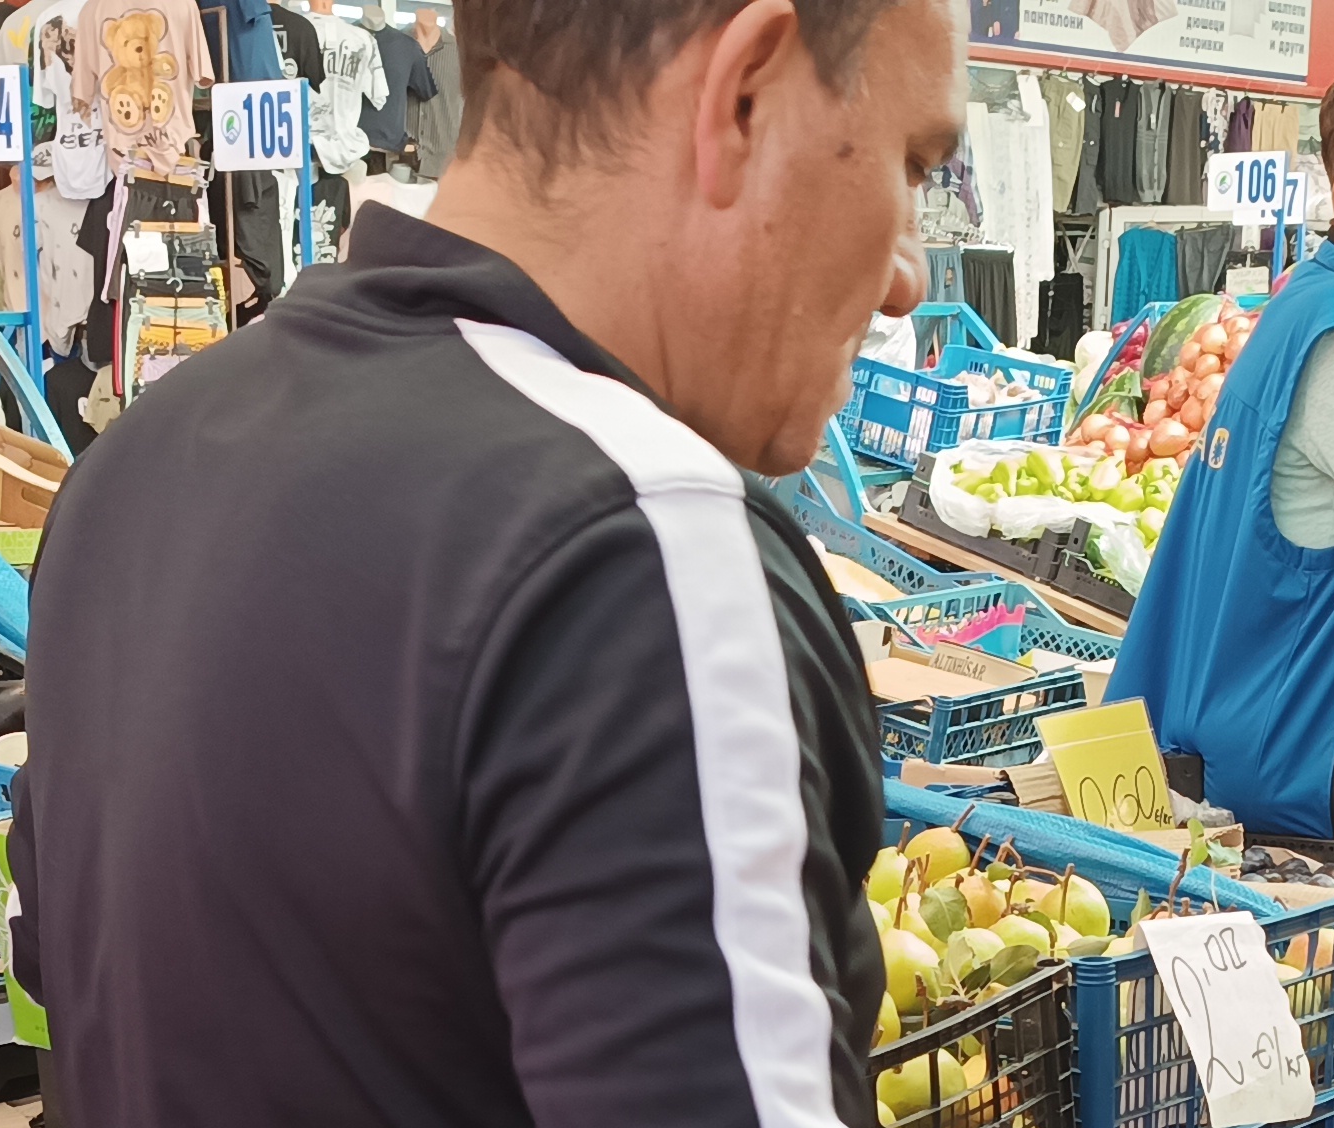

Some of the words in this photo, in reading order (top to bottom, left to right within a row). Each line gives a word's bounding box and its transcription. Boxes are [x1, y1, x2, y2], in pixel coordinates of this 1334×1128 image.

[1023, 9, 1084, 30] панталони
[243, 90, 294, 159] 105
[1235, 159, 1277, 203] 106
